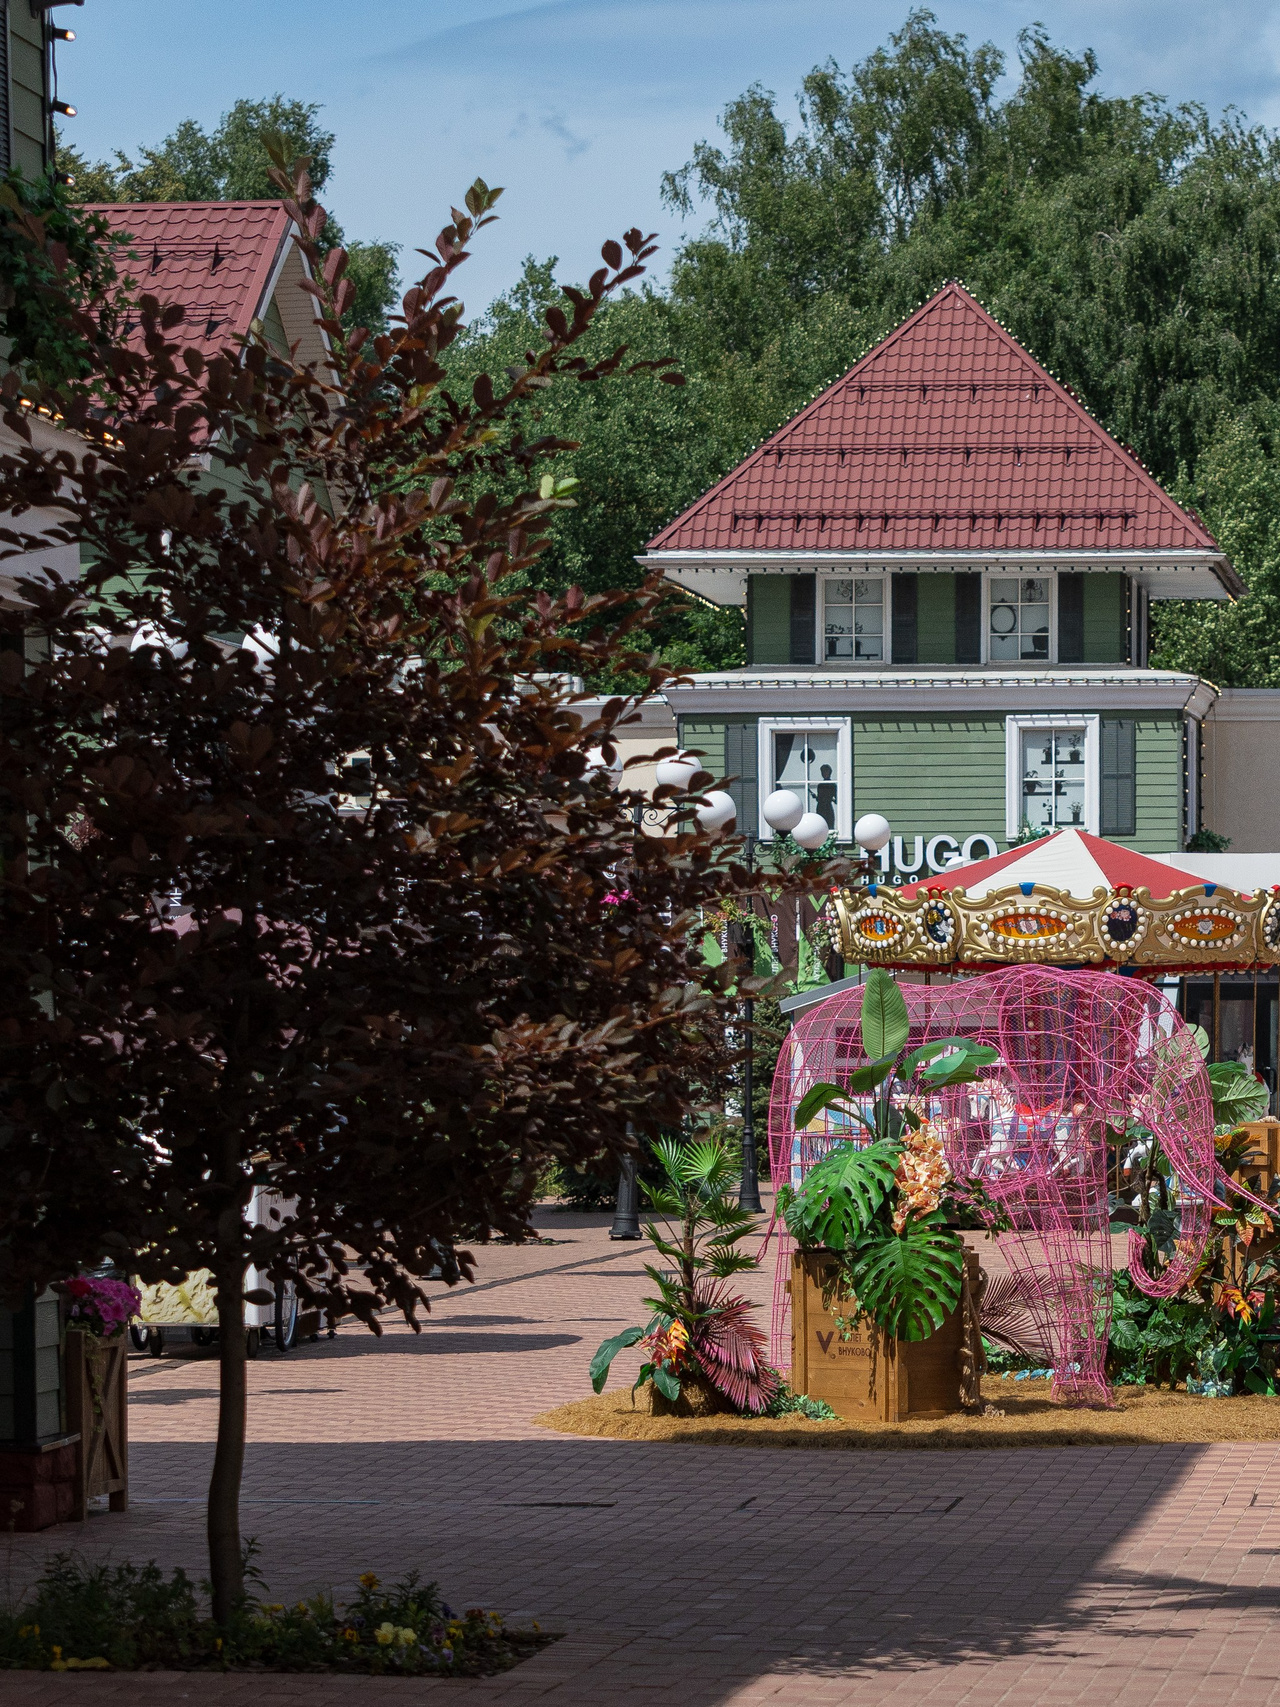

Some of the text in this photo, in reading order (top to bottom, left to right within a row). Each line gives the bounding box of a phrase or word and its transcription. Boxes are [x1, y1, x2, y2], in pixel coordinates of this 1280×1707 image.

[859, 834, 998, 873] HUGO
[860, 874, 919, 885] HUGO
[771, 914, 779, 953] ВНУКОО
[838, 1333, 862, 1342] АЛЕТ
[838, 1346, 871, 1357] ВНУКОВО
